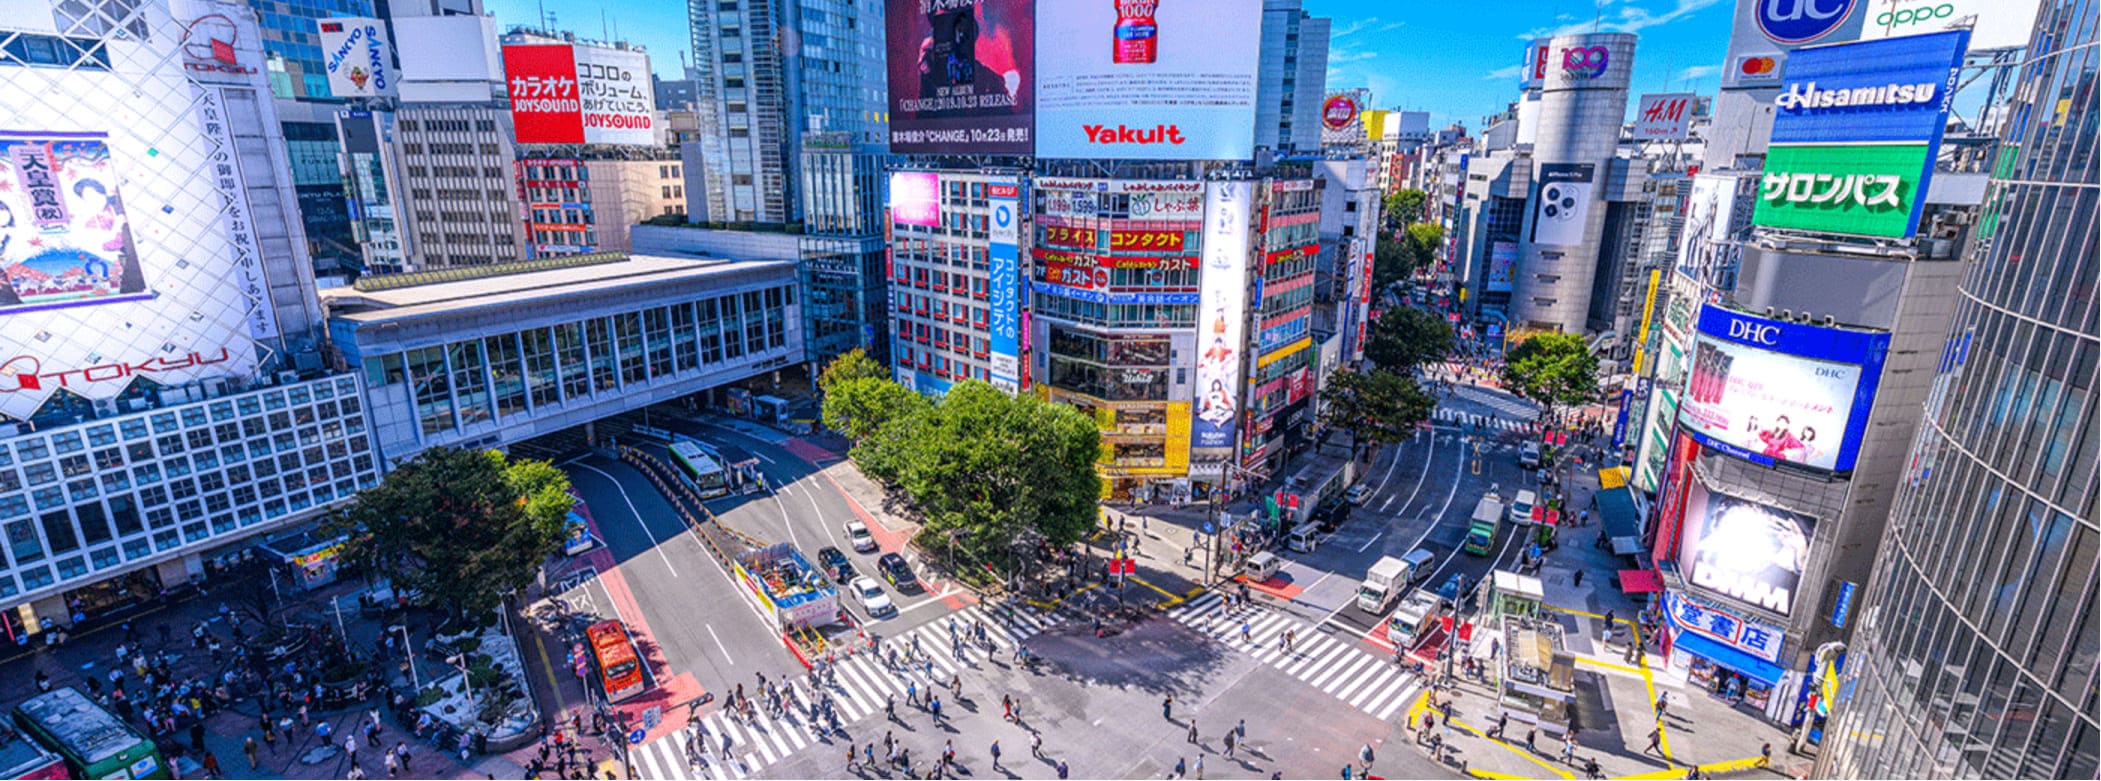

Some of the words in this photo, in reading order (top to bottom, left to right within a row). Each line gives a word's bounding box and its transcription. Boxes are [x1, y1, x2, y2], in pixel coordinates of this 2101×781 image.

[1119, 4, 1154, 18] 1000
[1877, 3, 1954, 28] oppo
[327, 27, 362, 73] SANKYO
[364, 24, 387, 90] SANKYO
[183, 62, 258, 75] TOKYU
[578, 62, 632, 82] ココロの
[1561, 45, 1609, 79] 109
[512, 75, 574, 97] カラオケ
[580, 79, 648, 100] ボリューム、
[1775, 81, 1936, 110] Hisamitsu
[514, 98, 579, 113] JOYSOUND
[582, 99, 650, 114] あげていこう。
[1642, 98, 1687, 123] H&M
[583, 113, 651, 129] JOYSOUND
[1082, 123, 1186, 145] Yakult
[1763, 171, 1901, 207] サロンパス
[1111, 231, 1182, 247] コンタクト
[1159, 256, 1192, 272] ガスト
[1062, 267, 1091, 286] ガスト
[992, 257, 1005, 337] アイシティ
[1005, 258, 1015, 339] コンタクトの
[1728, 318, 1781, 345] DHC
[40, 346, 229, 387] TOKYU
[1814, 366, 1846, 380] DHC
[1706, 438, 1720, 452] DHC
